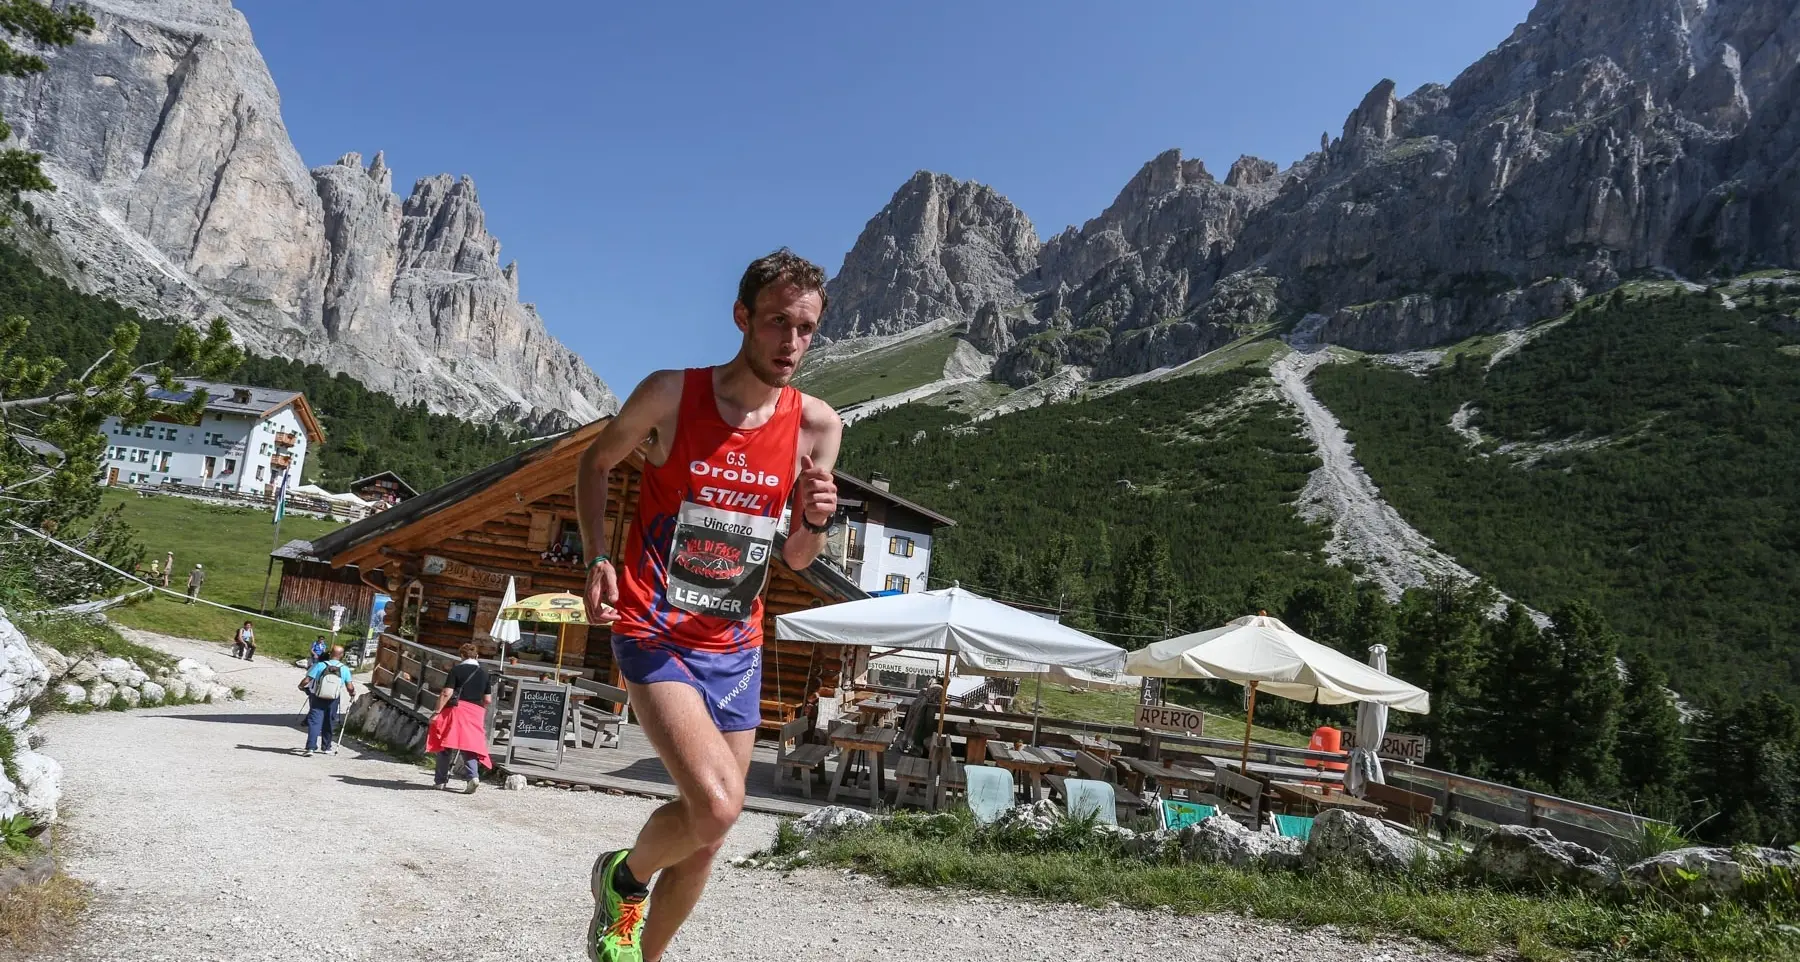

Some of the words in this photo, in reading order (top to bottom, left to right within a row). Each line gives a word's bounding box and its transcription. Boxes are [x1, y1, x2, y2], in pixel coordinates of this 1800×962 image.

[726, 451, 748, 467] G.S.
[690, 460, 779, 487] Orobie
[703, 516, 753, 536] Vincenzo
[675, 587, 742, 613] LEADER
[905, 666, 935, 675] SOUVENIR
[1140, 708, 1200, 729] APERTO
[1342, 731, 1424, 759] RIRANTE
